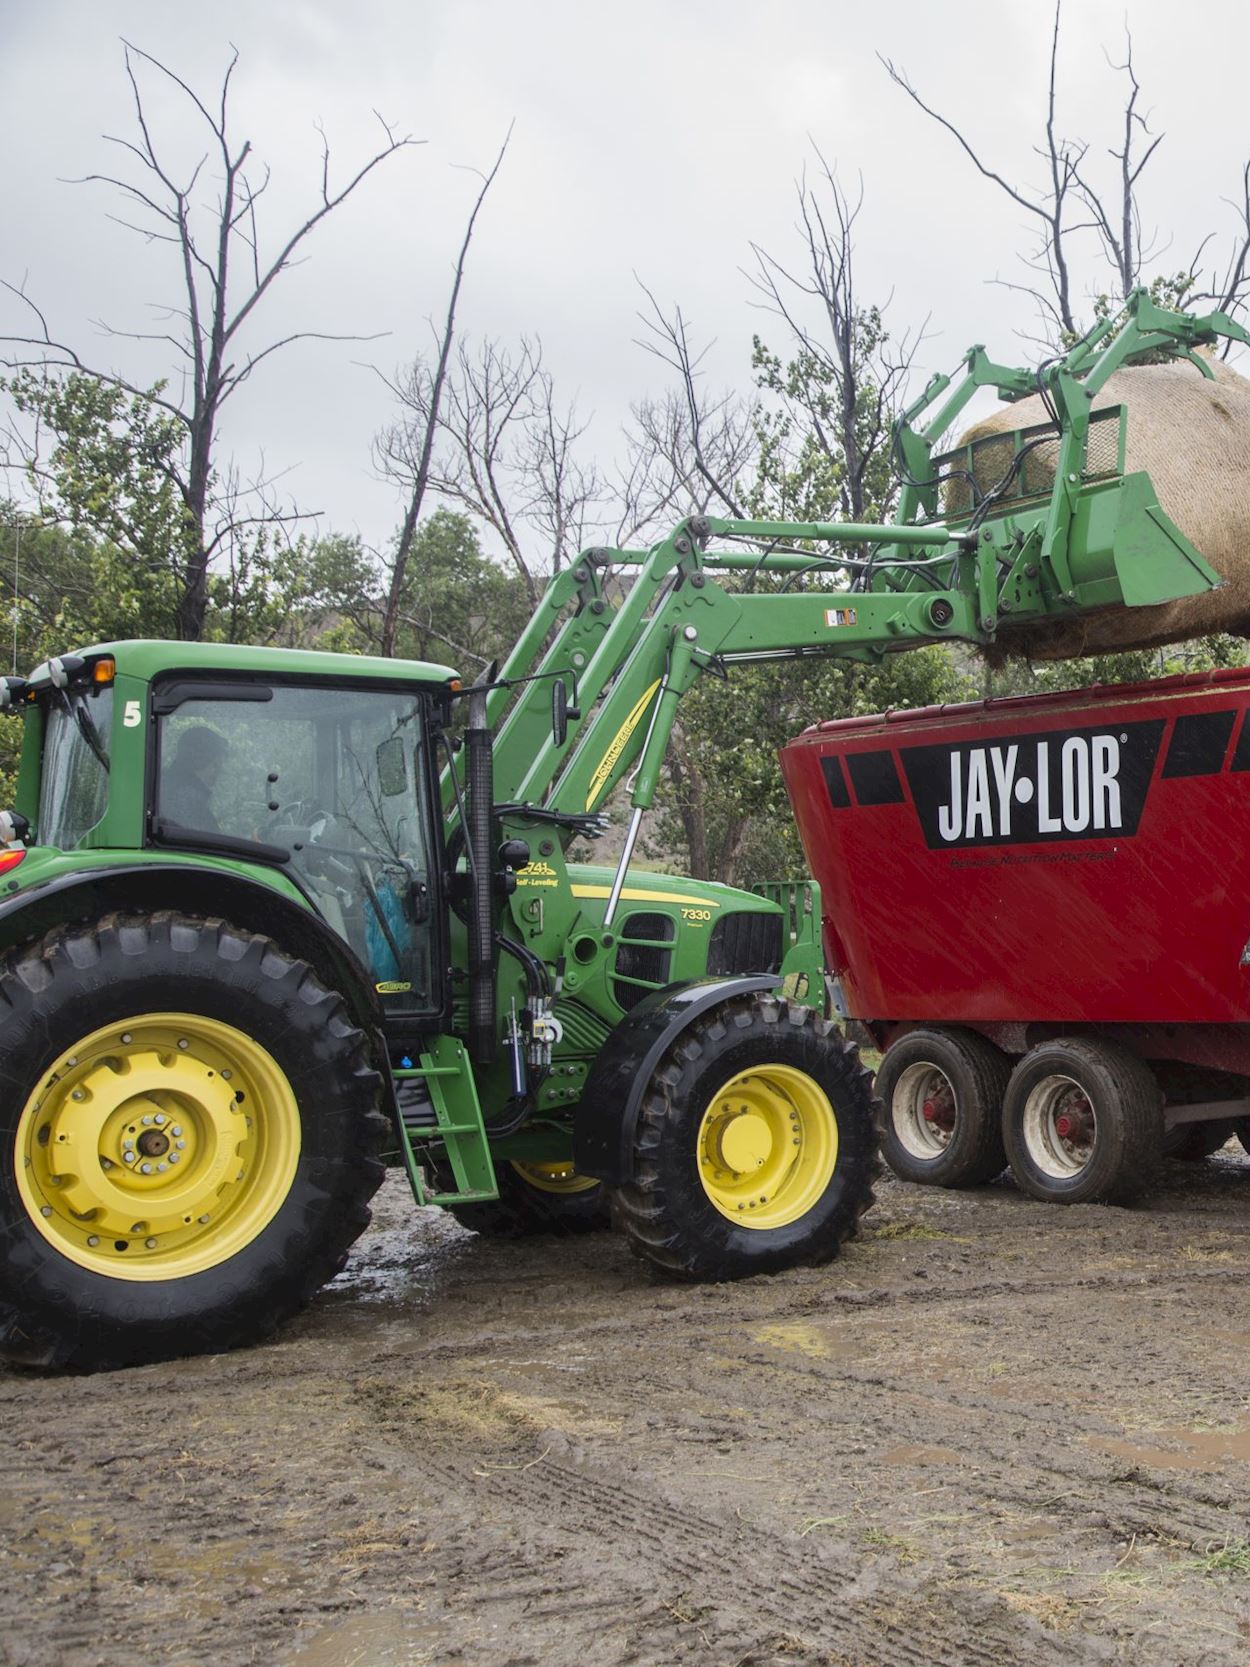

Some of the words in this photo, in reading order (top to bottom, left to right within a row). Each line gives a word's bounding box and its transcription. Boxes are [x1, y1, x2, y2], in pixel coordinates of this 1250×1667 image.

[123, 700, 142, 728] 5
[527, 861, 548, 874] 741
[681, 908, 711, 921] 7330
